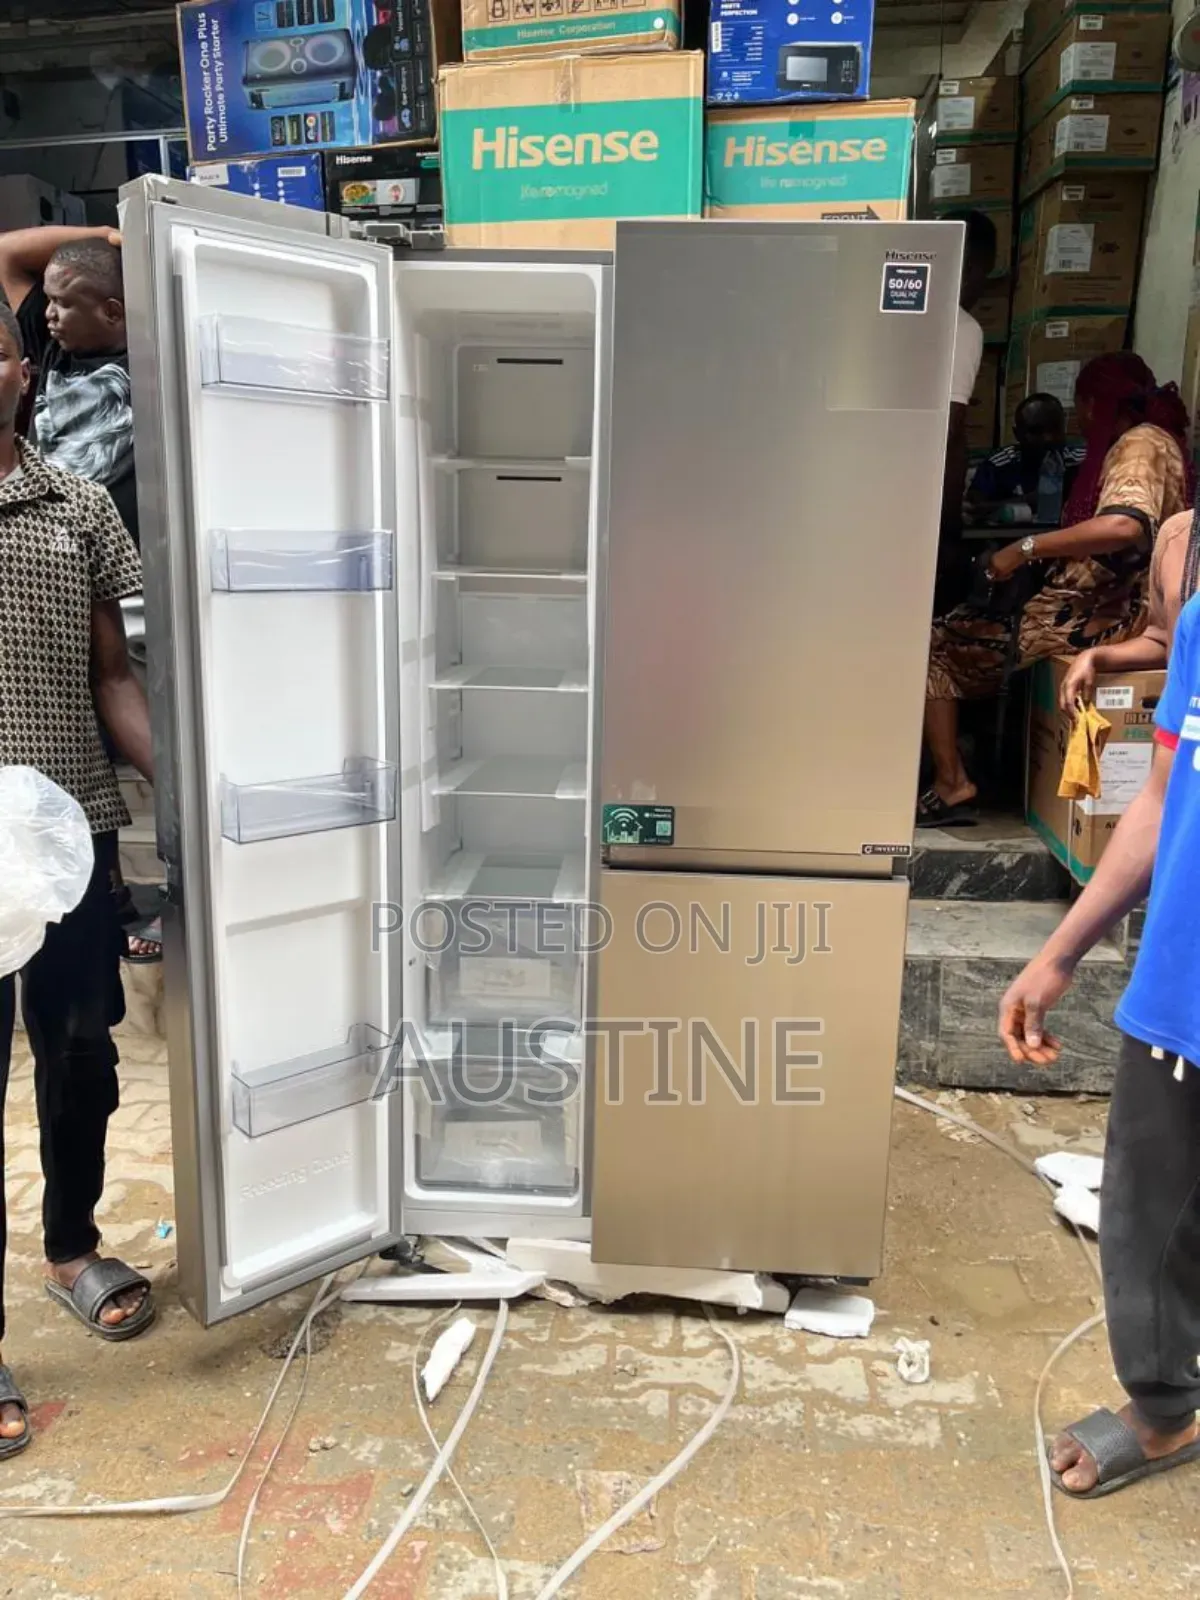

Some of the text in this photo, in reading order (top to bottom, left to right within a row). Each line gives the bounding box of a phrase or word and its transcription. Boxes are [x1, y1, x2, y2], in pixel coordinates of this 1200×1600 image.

[517, 21, 616, 40] Hisense Corporation
[198, 12, 217, 151] Party Rocker One Plus
[211, 19, 228, 143] Ultimate Party Starter
[335, 155, 373, 165] Hisense
[472, 126, 659, 170] Hisense
[724, 136, 888, 168] Hisense
[885, 250, 937, 260] Hisense
[888, 278, 923, 290] 50/60
